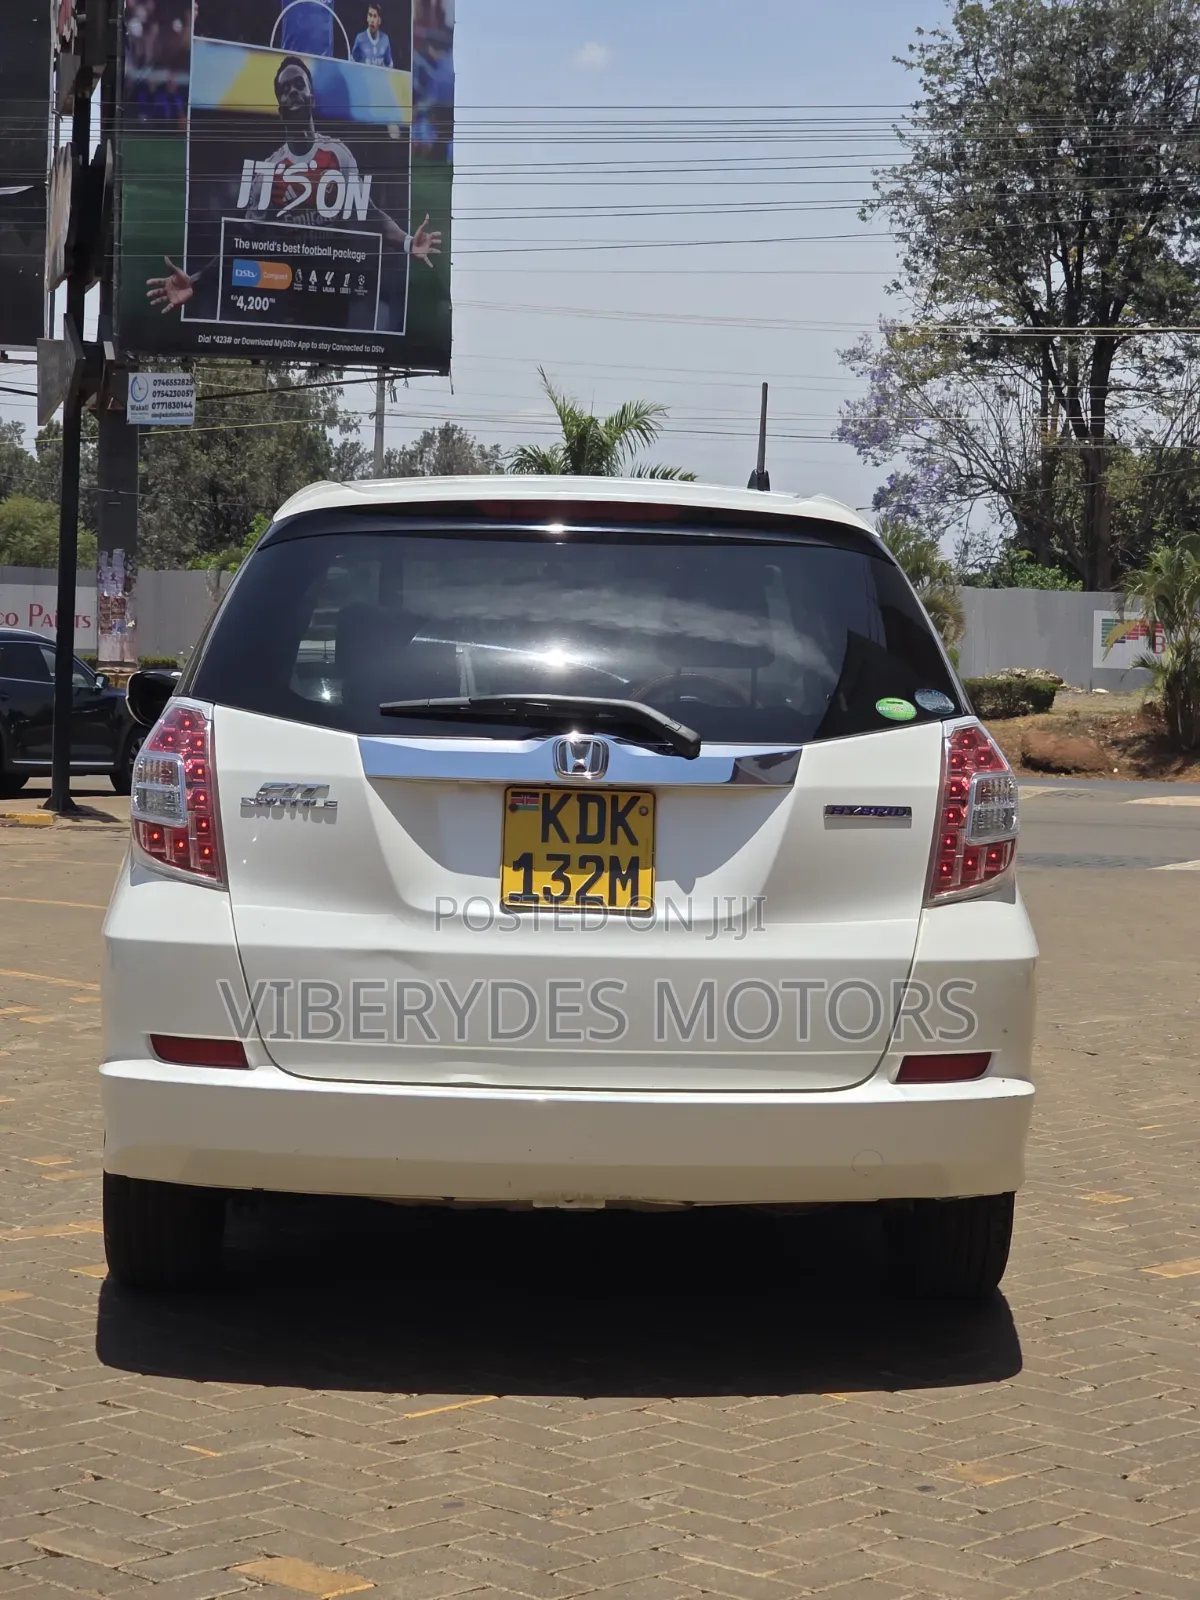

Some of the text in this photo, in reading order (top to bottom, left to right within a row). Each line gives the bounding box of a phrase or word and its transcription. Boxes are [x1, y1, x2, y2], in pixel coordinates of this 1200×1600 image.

[237, 159, 372, 220] IT'S ON
[233, 237, 366, 263] The world's best football package
[236, 294, 270, 312] 4,200
[198, 334, 212, 343] Dial
[233, 337, 241, 345] or
[241, 337, 273, 347] Download
[273, 338, 297, 349] MyDStv
[297, 340, 311, 351] App
[311, 341, 318, 349] to
[318, 342, 331, 352] stay
[331, 342, 364, 352] Connected
[364, 344, 371, 353] to
[371, 345, 385, 354] DStv
[151, 401, 193, 410] 0771830144
[541, 793, 641, 846] KDK
[508, 853, 640, 907] 132M
